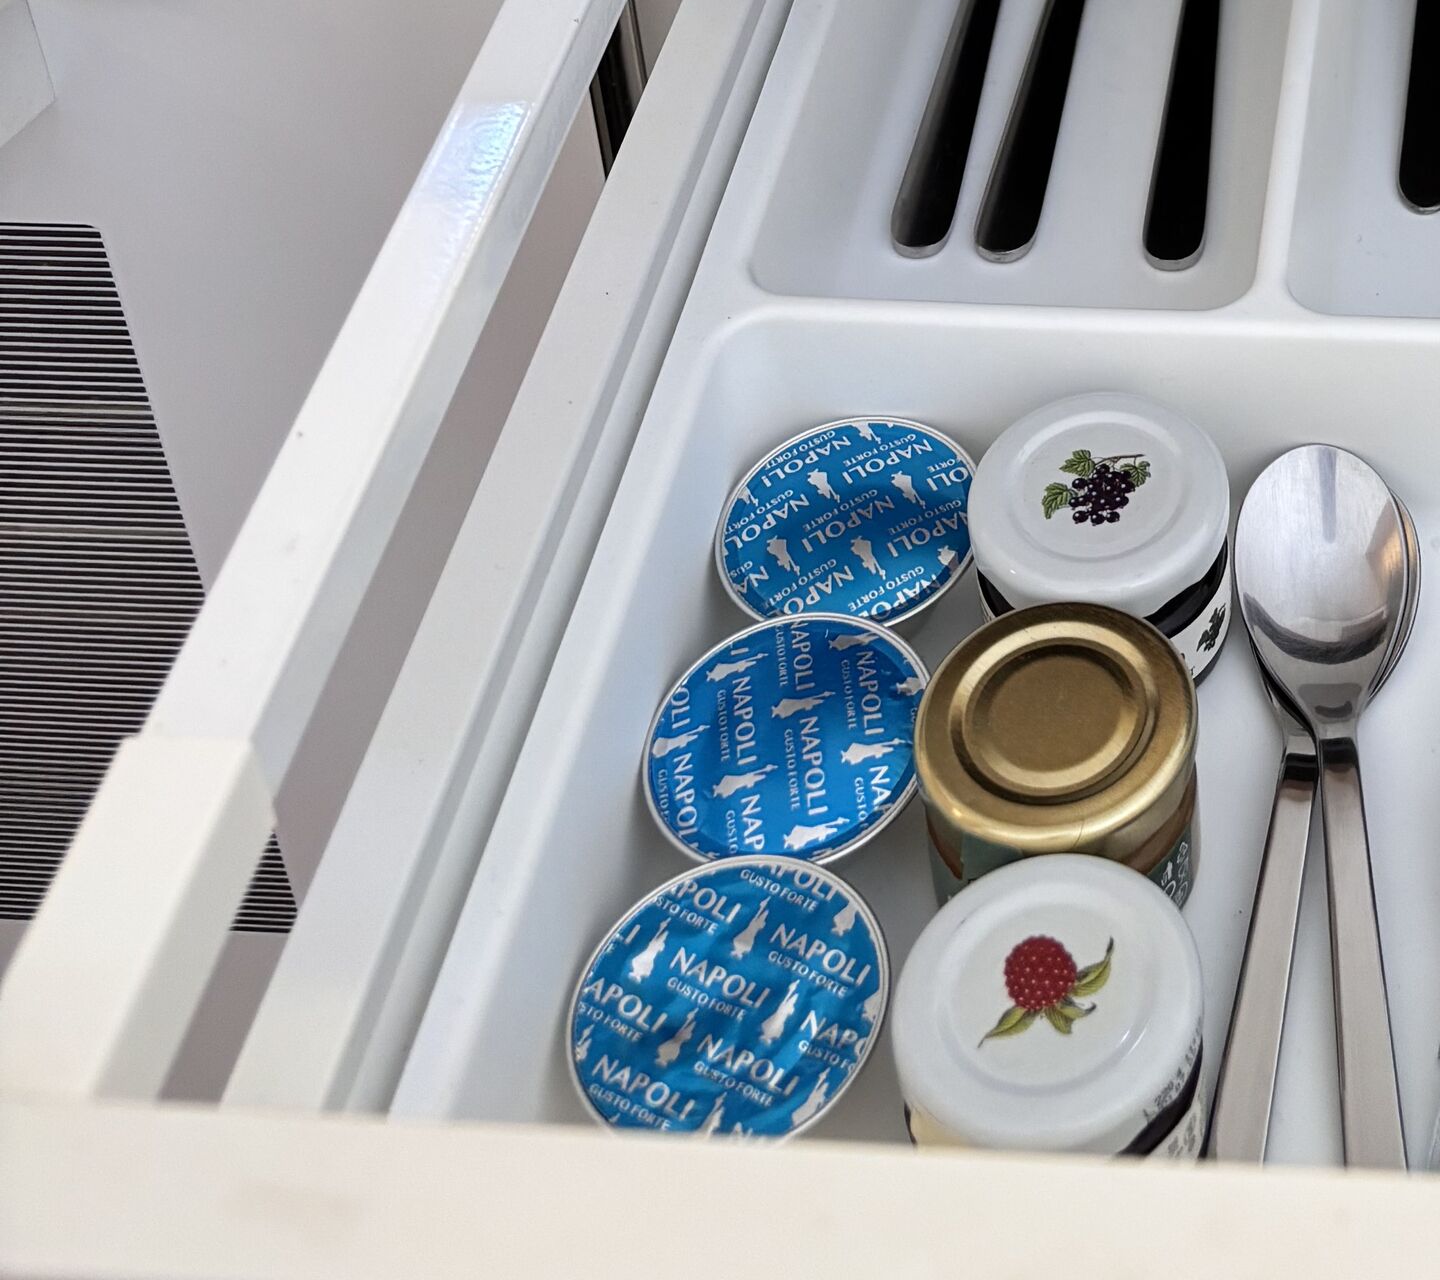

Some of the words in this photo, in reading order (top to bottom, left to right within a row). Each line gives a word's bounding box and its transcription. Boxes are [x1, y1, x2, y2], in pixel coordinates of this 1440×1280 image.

[761, 436, 851, 487] NAPOLI
[799, 430, 836, 452] GUSTO
[842, 439, 933, 484] NAPOLI
[843, 448, 878, 468] FORTE
[880, 433, 917, 452] GUSTO
[757, 489, 794, 514] GUSTO
[803, 508, 838, 532] FORTE
[839, 489, 878, 512] GUSTO
[925, 499, 961, 519] GUSTO
[801, 495, 895, 553] NAPOLI
[799, 558, 837, 585] GUSTO
[886, 566, 924, 590] GUSTO
[848, 586, 885, 612] FORTE
[856, 651, 885, 736] NAPOLI
[732, 676, 758, 766] NAPOLI
[800, 716, 829, 816] NAPOLI
[740, 869, 782, 894] GUSTO
[779, 886, 819, 913] FORTE
[680, 907, 719, 935] FORTE
[768, 951, 809, 976] GUSTO
[808, 969, 849, 998] FORTE
[769, 923, 871, 987] NAPOLI
[667, 976, 709, 1006] GUSTO
[708, 996, 749, 1022] FORTE
[669, 947, 771, 1009] NAPOLI
[604, 1015, 644, 1042] FORTE
[697, 1034, 799, 1096] NAPOLI
[798, 1040, 841, 1065] GUSTO
[592, 1054, 695, 1121] NAPOLI
[693, 1061, 736, 1088] GUSTO
[735, 1082, 775, 1107] FORTE
[589, 1082, 630, 1111] GUSTO
[630, 1103, 673, 1131] FORTE
